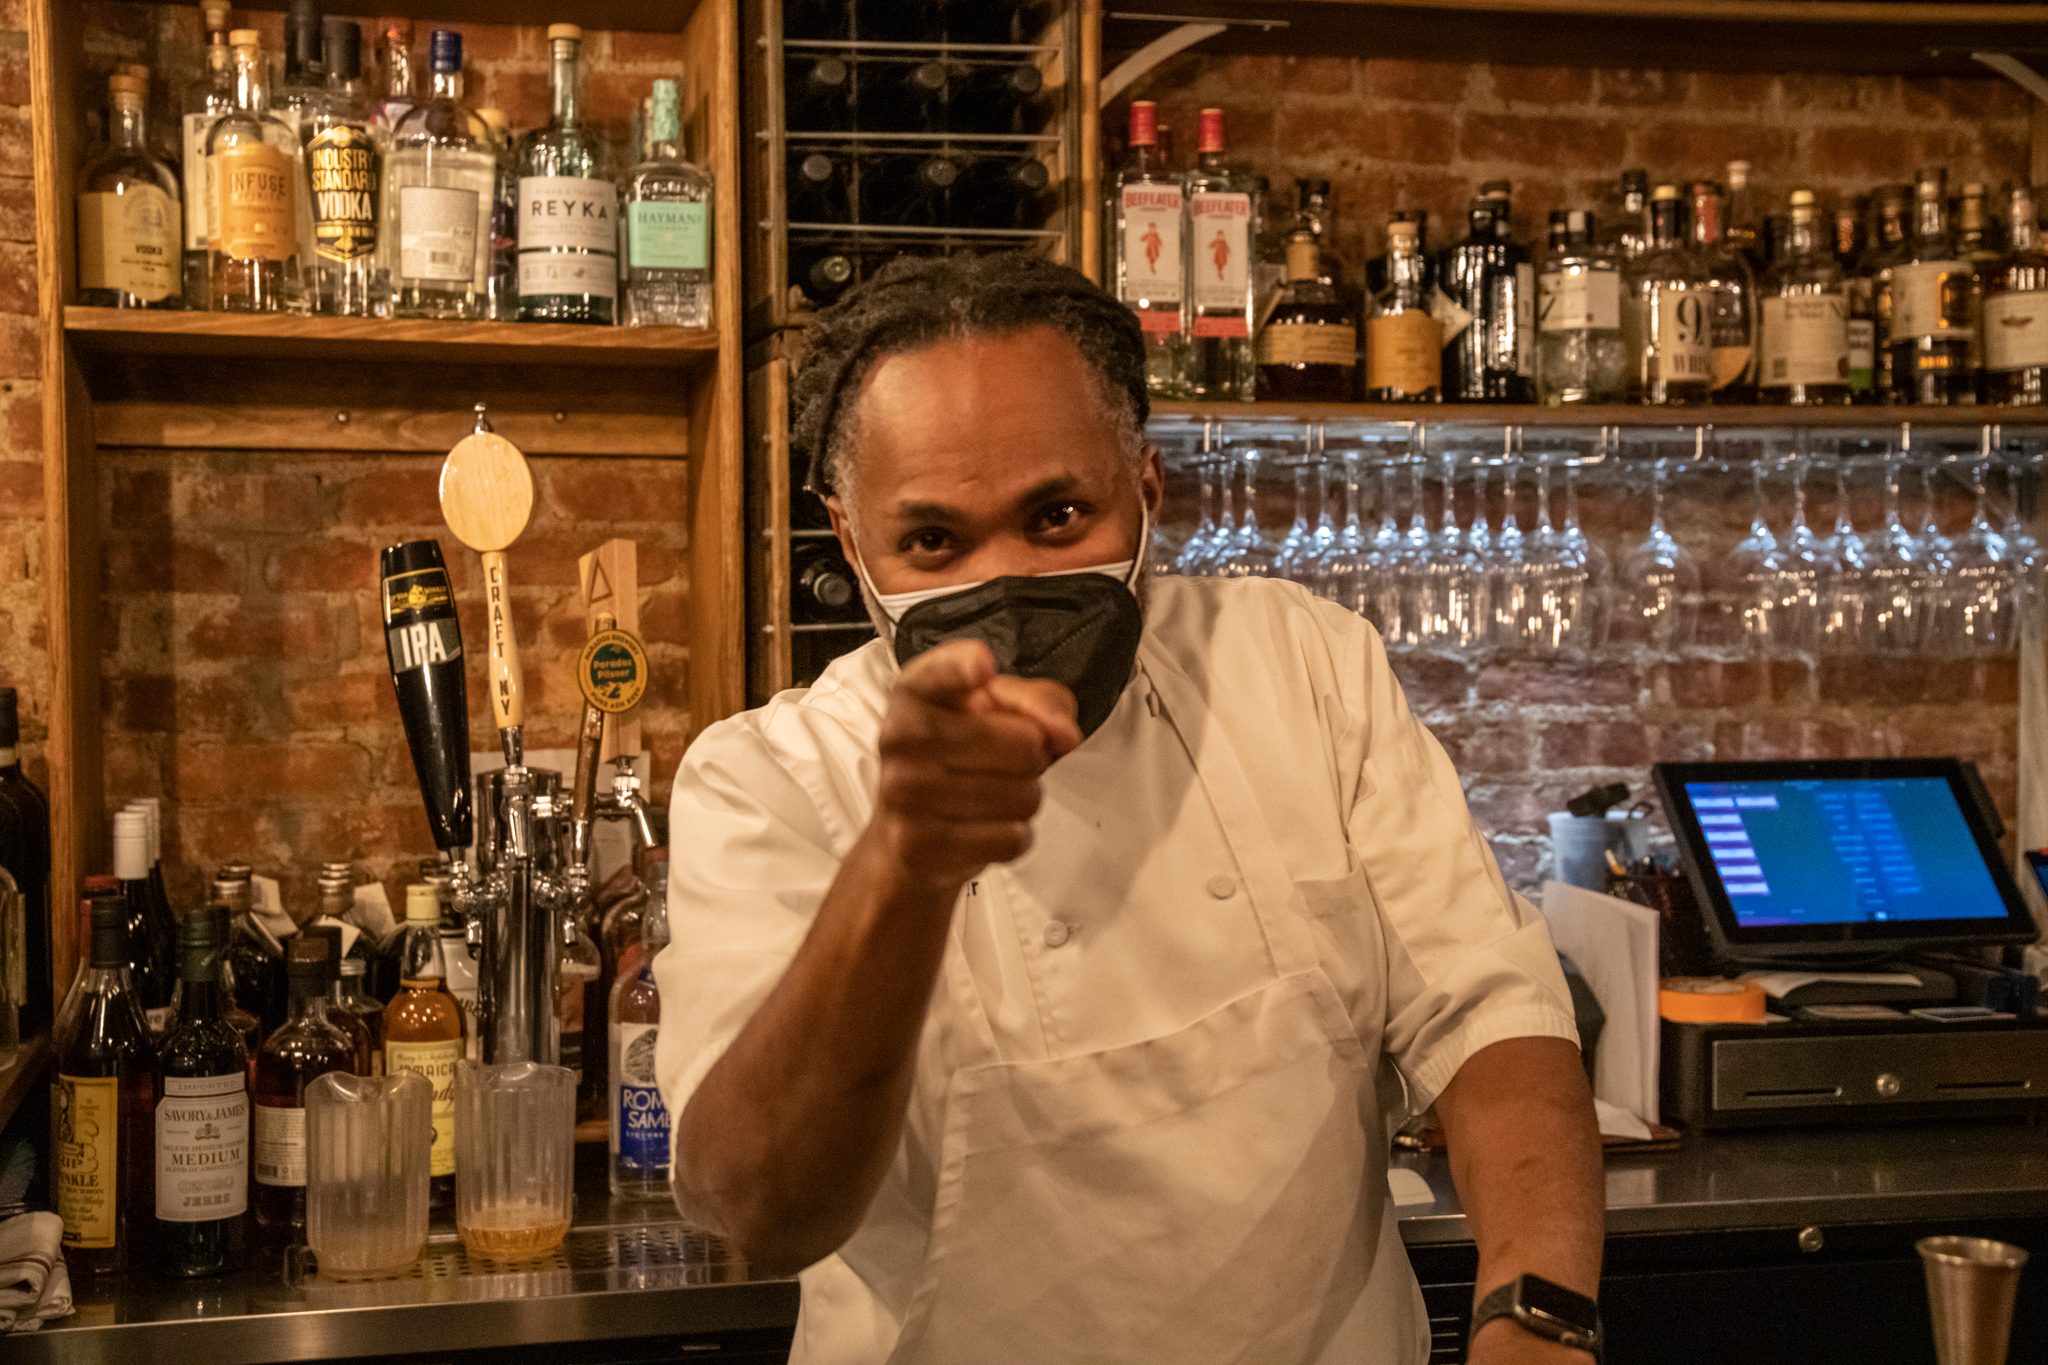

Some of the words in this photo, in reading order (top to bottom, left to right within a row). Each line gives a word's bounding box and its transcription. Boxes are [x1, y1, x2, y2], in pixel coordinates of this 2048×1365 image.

[312, 169, 376, 191] STANDARD
[318, 191, 372, 221] VODKA
[532, 200, 607, 219] REYKA
[400, 621, 447, 668] IPA
[489, 566, 504, 659] CRAFT
[499, 679, 510, 716] NY
[171, 1148, 241, 1166] MEDIUM
[60, 1174, 99, 1188] INKLE
